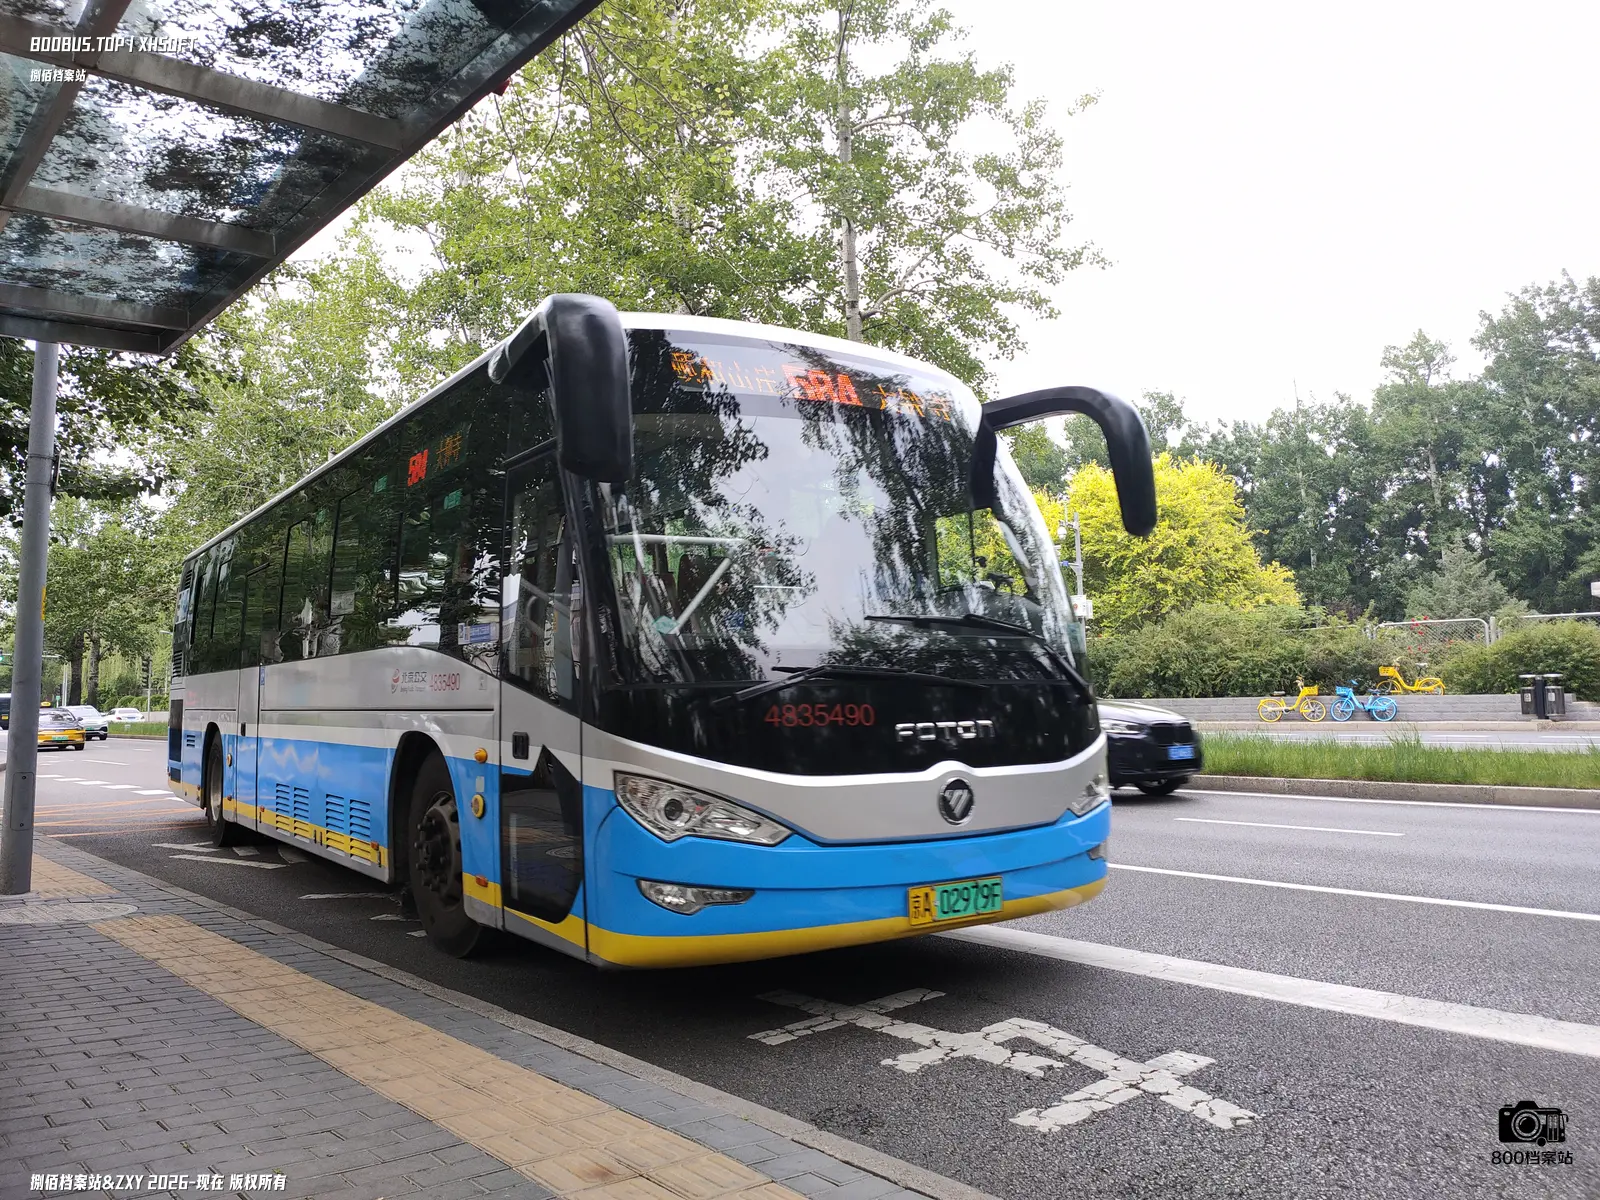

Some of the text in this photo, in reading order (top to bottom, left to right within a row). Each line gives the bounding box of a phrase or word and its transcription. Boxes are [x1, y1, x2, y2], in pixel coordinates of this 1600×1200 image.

[401, 671, 427, 684] 北京公交
[764, 703, 875, 727] 4835490
[895, 719, 996, 742] FOTON
